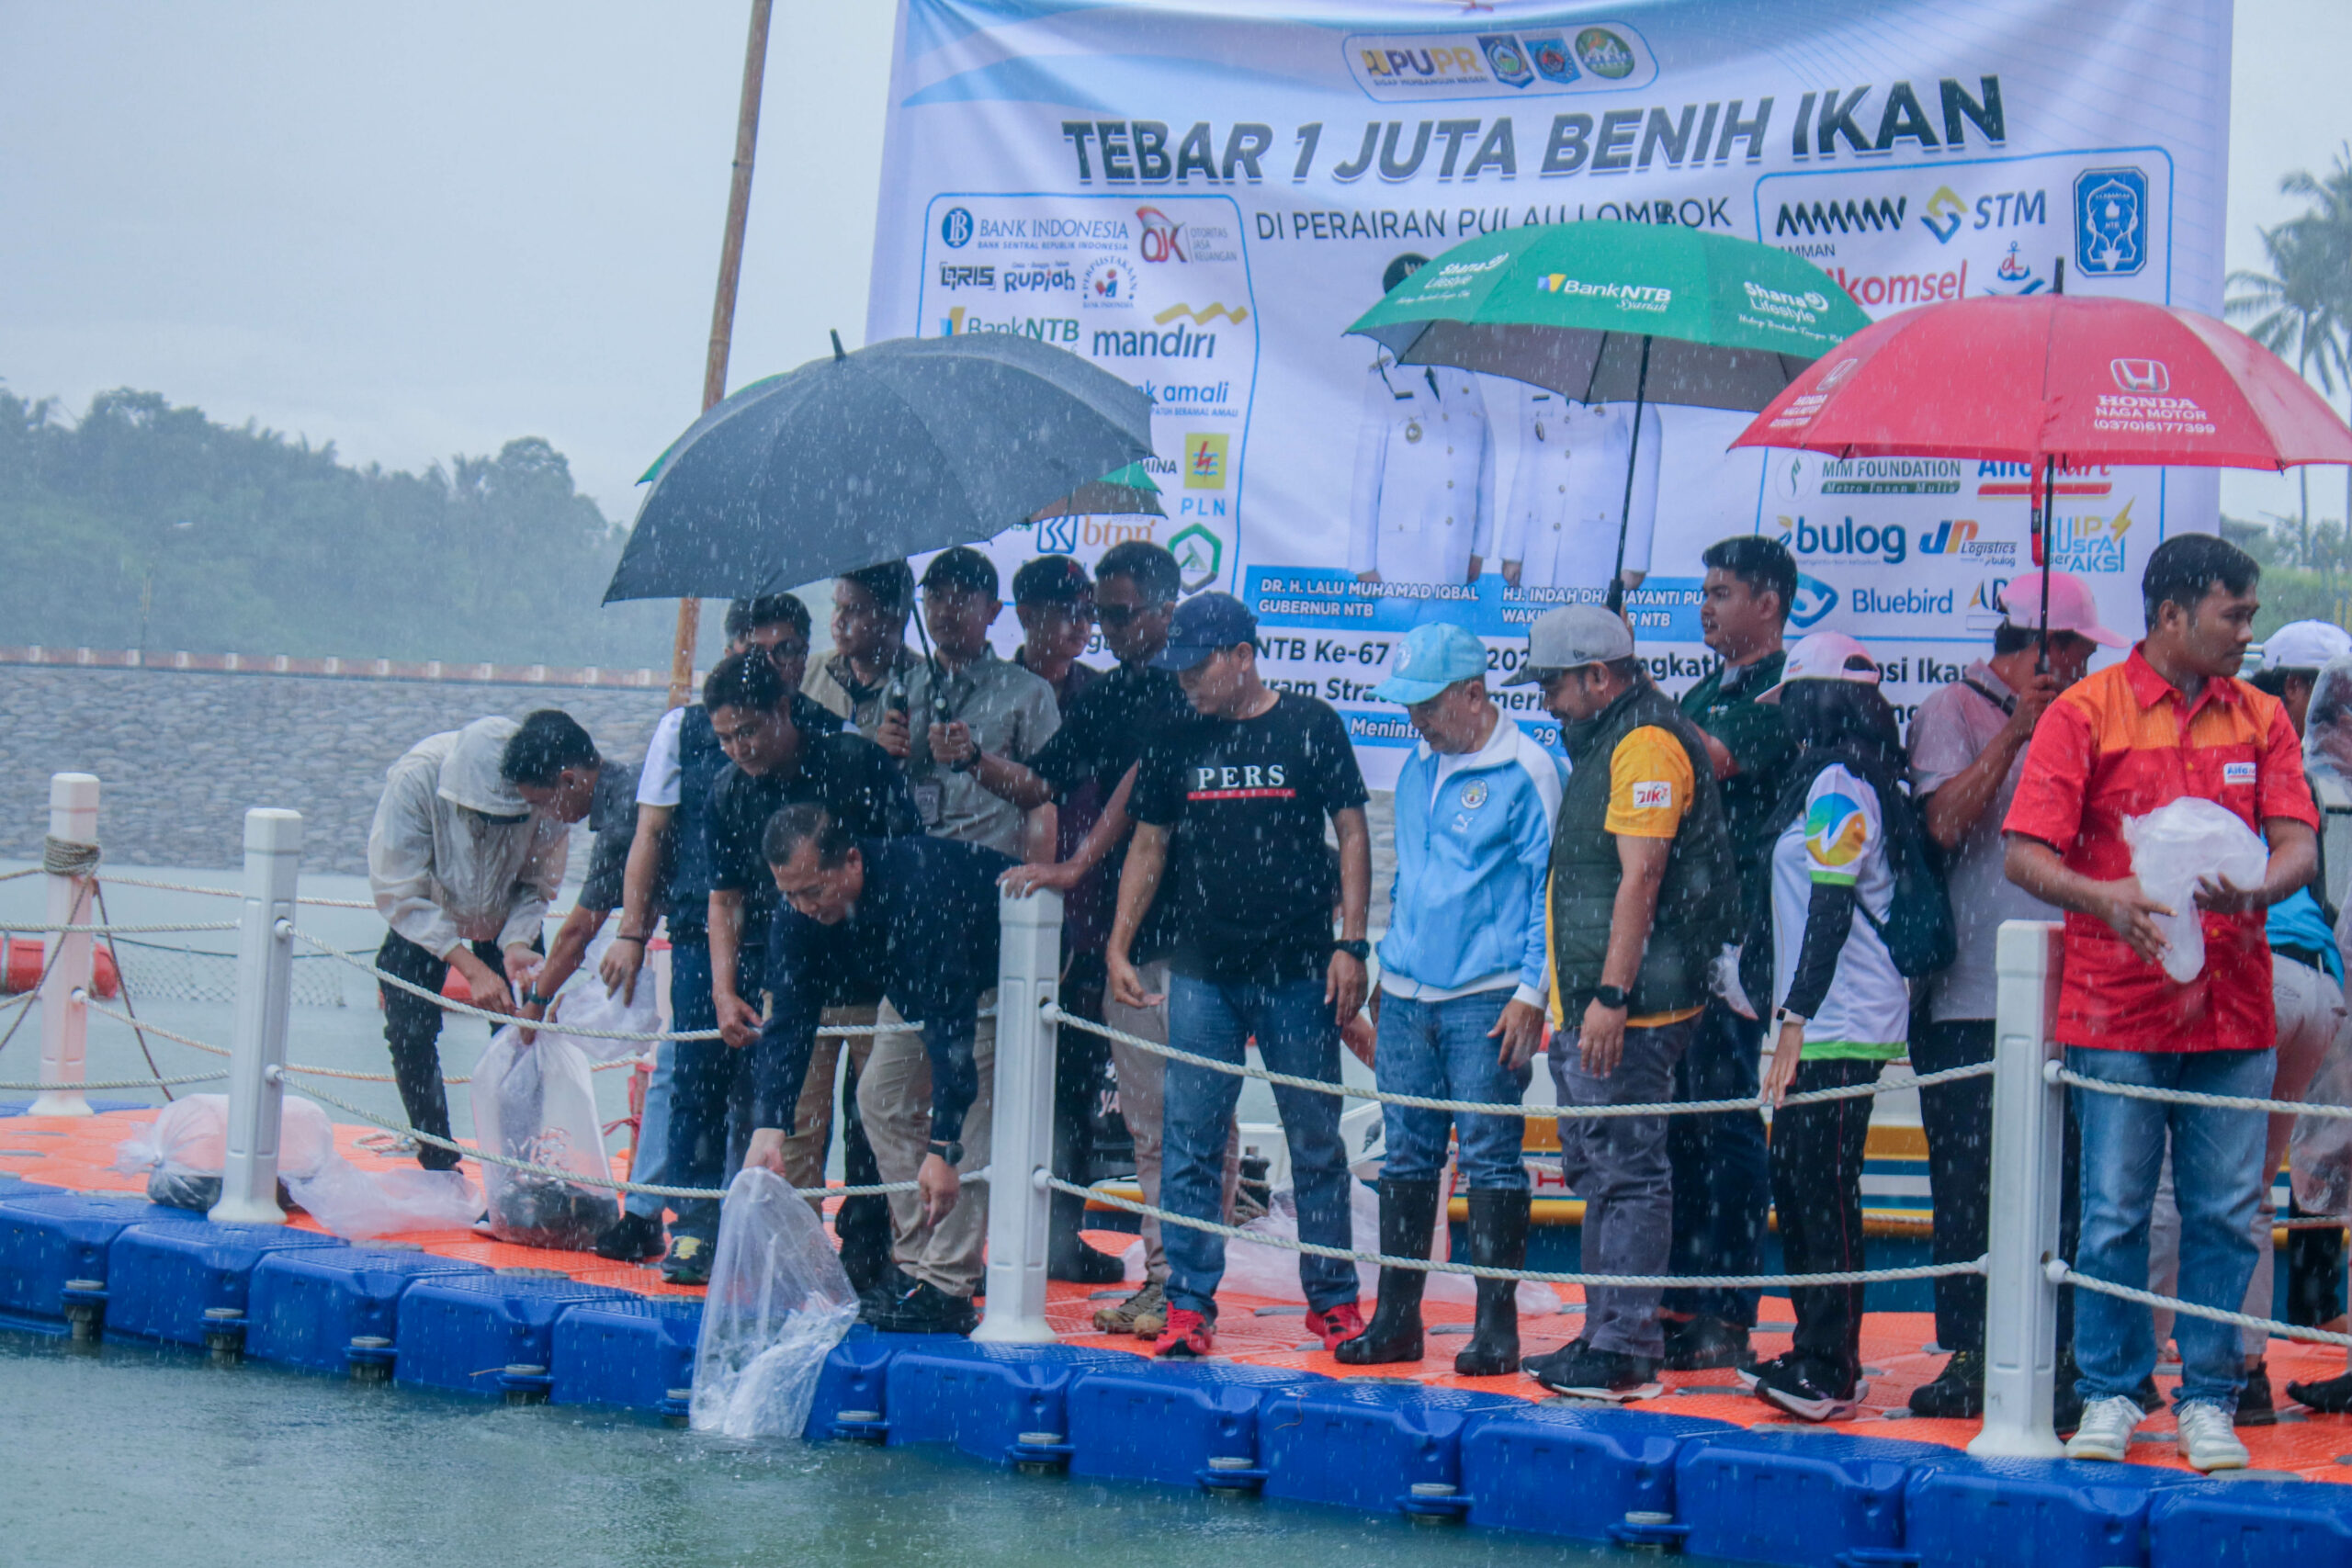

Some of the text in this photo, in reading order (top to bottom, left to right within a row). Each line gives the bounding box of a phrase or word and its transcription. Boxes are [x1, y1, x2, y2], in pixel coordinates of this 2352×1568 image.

[1385, 46, 1483, 76] PUPR
[1061, 74, 2007, 184] TEBAR 1 JUTA BENIH IKAN
[1973, 189, 2046, 230] STM
[979, 219, 1129, 239] BANK INDONESIA
[1190, 227, 1228, 238] OTORITAS
[1256, 211, 1284, 240] DI
[1293, 209, 1446, 240] PERAIRAN
[978, 241, 1000, 249] BANK
[1079, 242, 1128, 250] INDONESIA
[1194, 251, 1238, 262] KEUANGAN
[941, 265, 996, 291] QRIS
[1564, 279, 1672, 302] BankNTB
[1744, 280, 1808, 309] Sharia
[1750, 296, 1816, 323] Lifestyle
[1092, 323, 1216, 358] mandiri
[1163, 380, 1229, 403] amali
[2098, 395, 2199, 409] HONDA
[2095, 406, 2207, 421] NAGA MOTOR
[2094, 417, 2216, 434] (0370)6177399
[1823, 459, 1962, 478] MIM FOUNDATION
[1826, 482, 1862, 493] Metro
[1181, 497, 1227, 516] PLN
[1797, 515, 1906, 564] bulog
[1961, 540, 2017, 556] Logistics
[1261, 579, 1480, 602] DR. H. LALU MUHAMAD IQBAL
[1503, 586, 1525, 603] HJ.
[1530, 587, 1579, 604] INDAH
[1853, 587, 1954, 614] Bluebird
[1259, 599, 1374, 617] GUBERNUR NTB
[1640, 612, 1671, 626] NTB
[1256, 637, 1306, 660] NTB
[1314, 639, 1391, 665] Ke-67
[1532, 726, 1558, 747] 29
[1197, 764, 1285, 791] PERS
